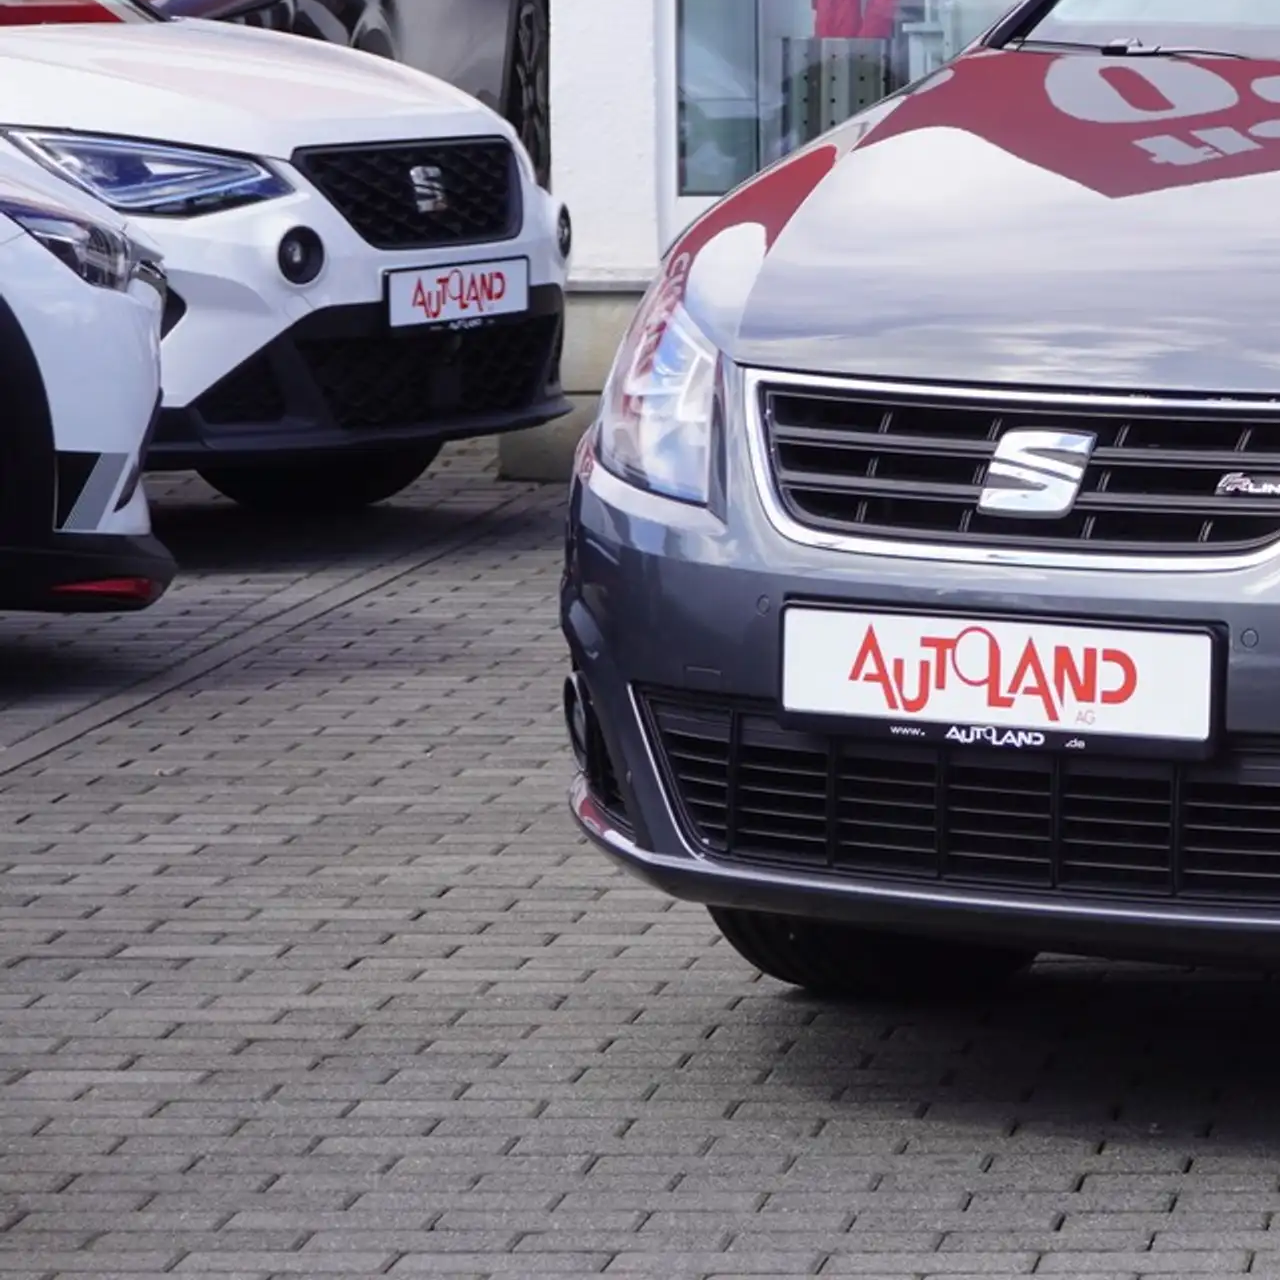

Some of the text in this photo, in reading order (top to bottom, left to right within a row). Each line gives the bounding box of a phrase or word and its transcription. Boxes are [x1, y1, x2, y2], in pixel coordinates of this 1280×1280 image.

[412, 268, 506, 319] AUTOLAND
[849, 624, 1138, 722] AUTOLAND
[1075, 709, 1097, 725] AG
[944, 725, 1046, 748] AUTOLAND
